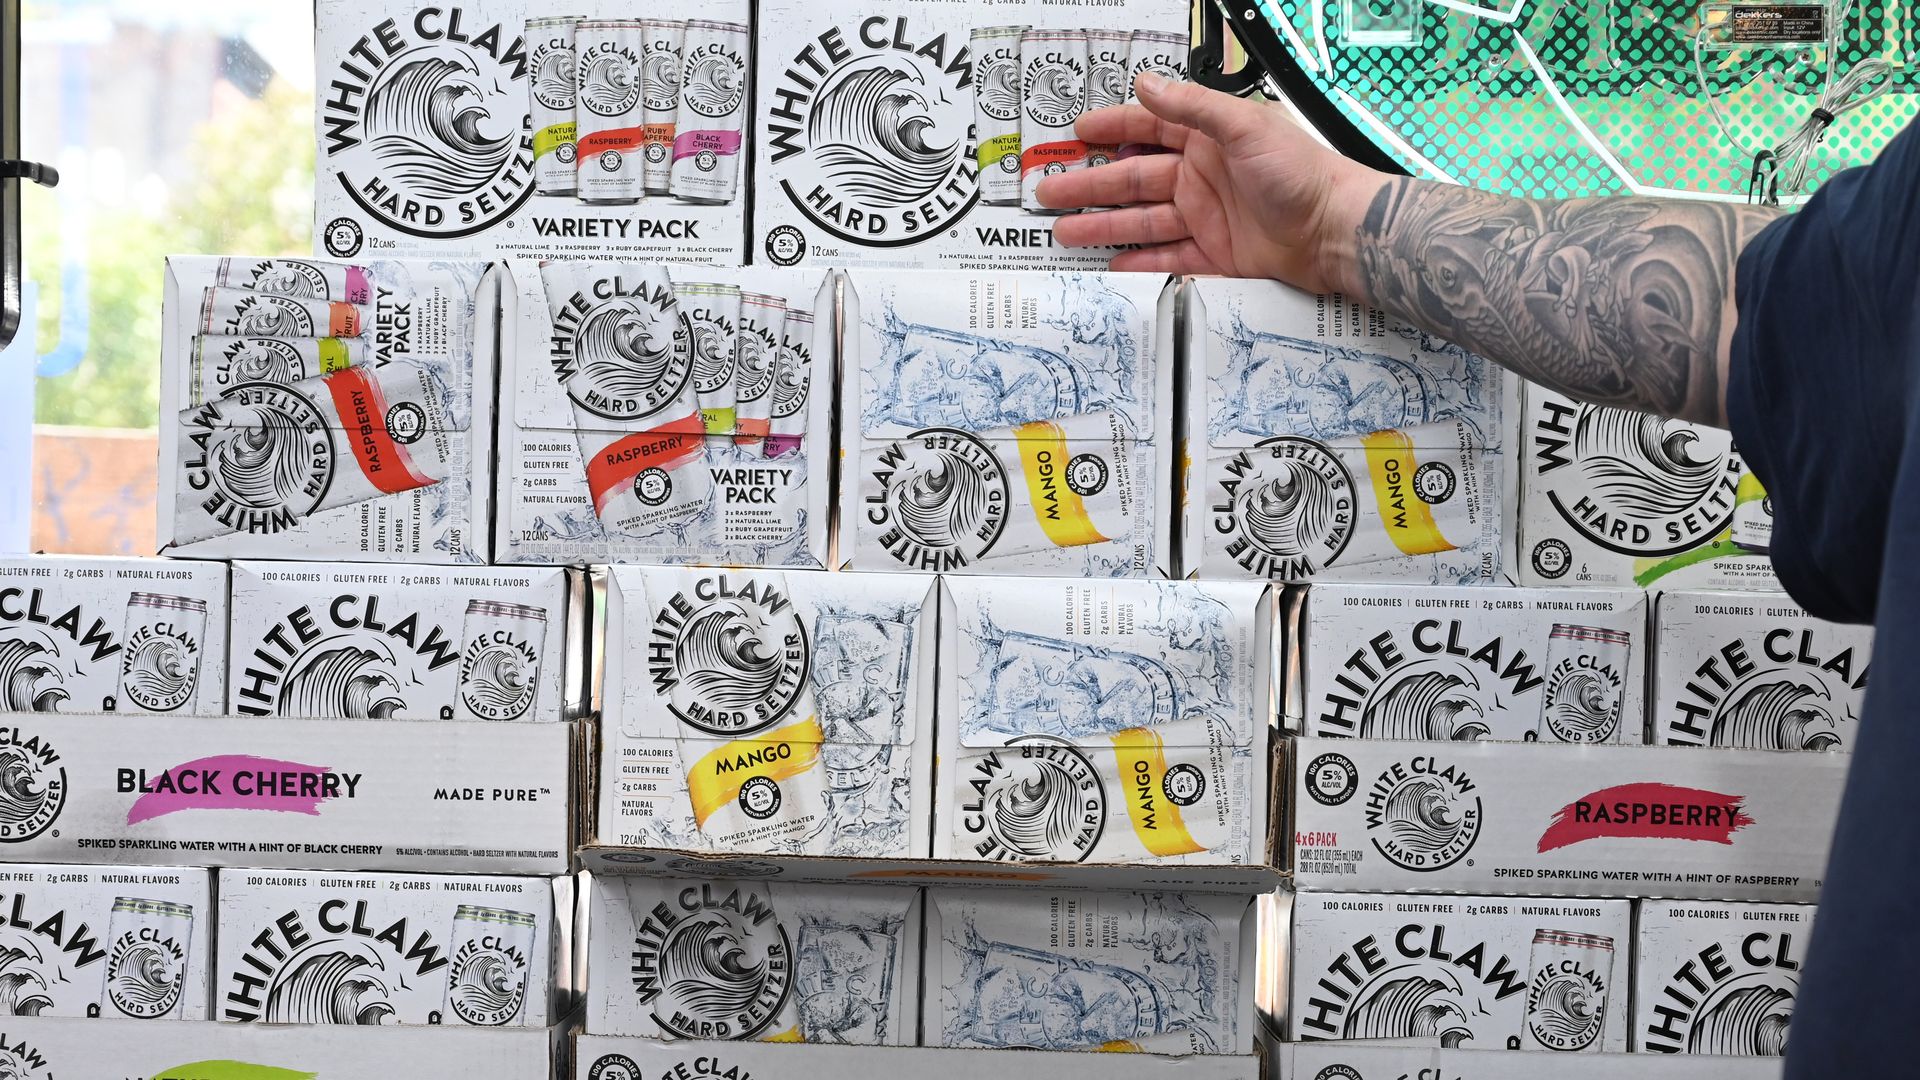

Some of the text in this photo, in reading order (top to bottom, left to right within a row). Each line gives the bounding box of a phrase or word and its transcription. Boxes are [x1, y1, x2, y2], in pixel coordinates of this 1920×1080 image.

[323, 7, 530, 156] WHITE CLAW
[768, 16, 974, 163] WHITE CLAW
[589, 136, 631, 145] RASPBERRY
[692, 141, 723, 149] CHERRY
[696, 134, 721, 142] BLACK
[1033, 148, 1076, 157] RASPBERRY
[362, 176, 443, 226] HARD
[806, 185, 887, 234] HARD
[368, 237, 396, 248] 12 CANS
[532, 217, 700, 238] VARIETY PACK
[376, 286, 393, 368] VARIETY
[393, 303, 410, 353] PACK
[551, 276, 677, 384] WHITE CLAW
[585, 329, 687, 413] HARD SELTZER
[240, 390, 327, 497] HARD SELTZER
[351, 390, 381, 473] RASPBERRY
[185, 401, 298, 534] WHITE CLAW
[606, 436, 683, 466] RASPBERRY
[710, 469, 792, 485] VARIETY
[726, 487, 776, 503] PACK
[924, 435, 1001, 541] HARD SELTZER
[1037, 451, 1059, 520] MANGO
[1385, 459, 1407, 529] MANGO
[867, 443, 968, 571] WHITE CLAW
[1213, 452, 1314, 580] WHITE CLAW
[1573, 496, 1650, 544] HARD
[1544, 552, 1559, 560] 5%
[31, 569, 192, 580] FREE 2g CARBS NATURAL FLAVORS
[262, 572, 529, 587] 100 CALORIES GLUTEN FREE 2g CARBS NATURAL FLAVORS
[1576, 573, 1592, 581] CANS
[1343, 598, 1613, 611] 100 CALORIES GLUTEN FREE 2g CARBS NATURAL FLAVORS
[1695, 606, 1799, 617] 100 CALORIES GLUTEN
[0, 588, 123, 662] CLAW
[329, 594, 460, 671] CLAW
[648, 575, 790, 696] WHITE CLAW
[462, 631, 537, 685] WHITE CLAW
[1412, 619, 1544, 694] CLAW
[468, 676, 535, 717] HARD SELTZER
[686, 633, 801, 727] HARD SELTZER
[623, 766, 669, 774] GLUTEN FREE
[639, 749, 673, 757] CALORIES
[715, 743, 791, 775] MANGO
[1309, 755, 1355, 777] 100 CALORIES
[117, 768, 362, 798] BLACK CHERRY
[622, 783, 657, 792] 2g CARBS
[963, 751, 1003, 833] CLAW
[1321, 781, 1342, 789] ALC/VOL
[1322, 770, 1342, 780] 5%
[434, 788, 483, 801] MADE
[622, 800, 653, 808] NATURAL
[1134, 760, 1157, 830] MANGO
[1365, 757, 1475, 830] WHITE CLAW
[1576, 801, 1741, 827] RASPBERRY
[78, 838, 382, 855] SPIKED SPARKLING WATER WITH A HINT OF BLACK CHERRY
[1317, 832, 1337, 846] PACK
[1385, 809, 1476, 865] HARD SELTZER
[247, 877, 522, 893] 100 CALORIES GLUTEN FREE 2g CARBS NATURAL FLAVORS
[1494, 868, 1799, 886] SPIKED SPARKLING WATER WITH A HINT OF RASPBERRY
[1323, 901, 1601, 916] 100 CALORIES GLUTEN FREE 2g CARBS NATURAL FLAVORS
[1669, 909, 1729, 919] 100 CALORIES
[318, 900, 449, 976] CLAW
[632, 883, 775, 1006] WHITE CLAW
[1395, 924, 1528, 1001] CLAW
[669, 943, 784, 1038] HARD SELTZER
